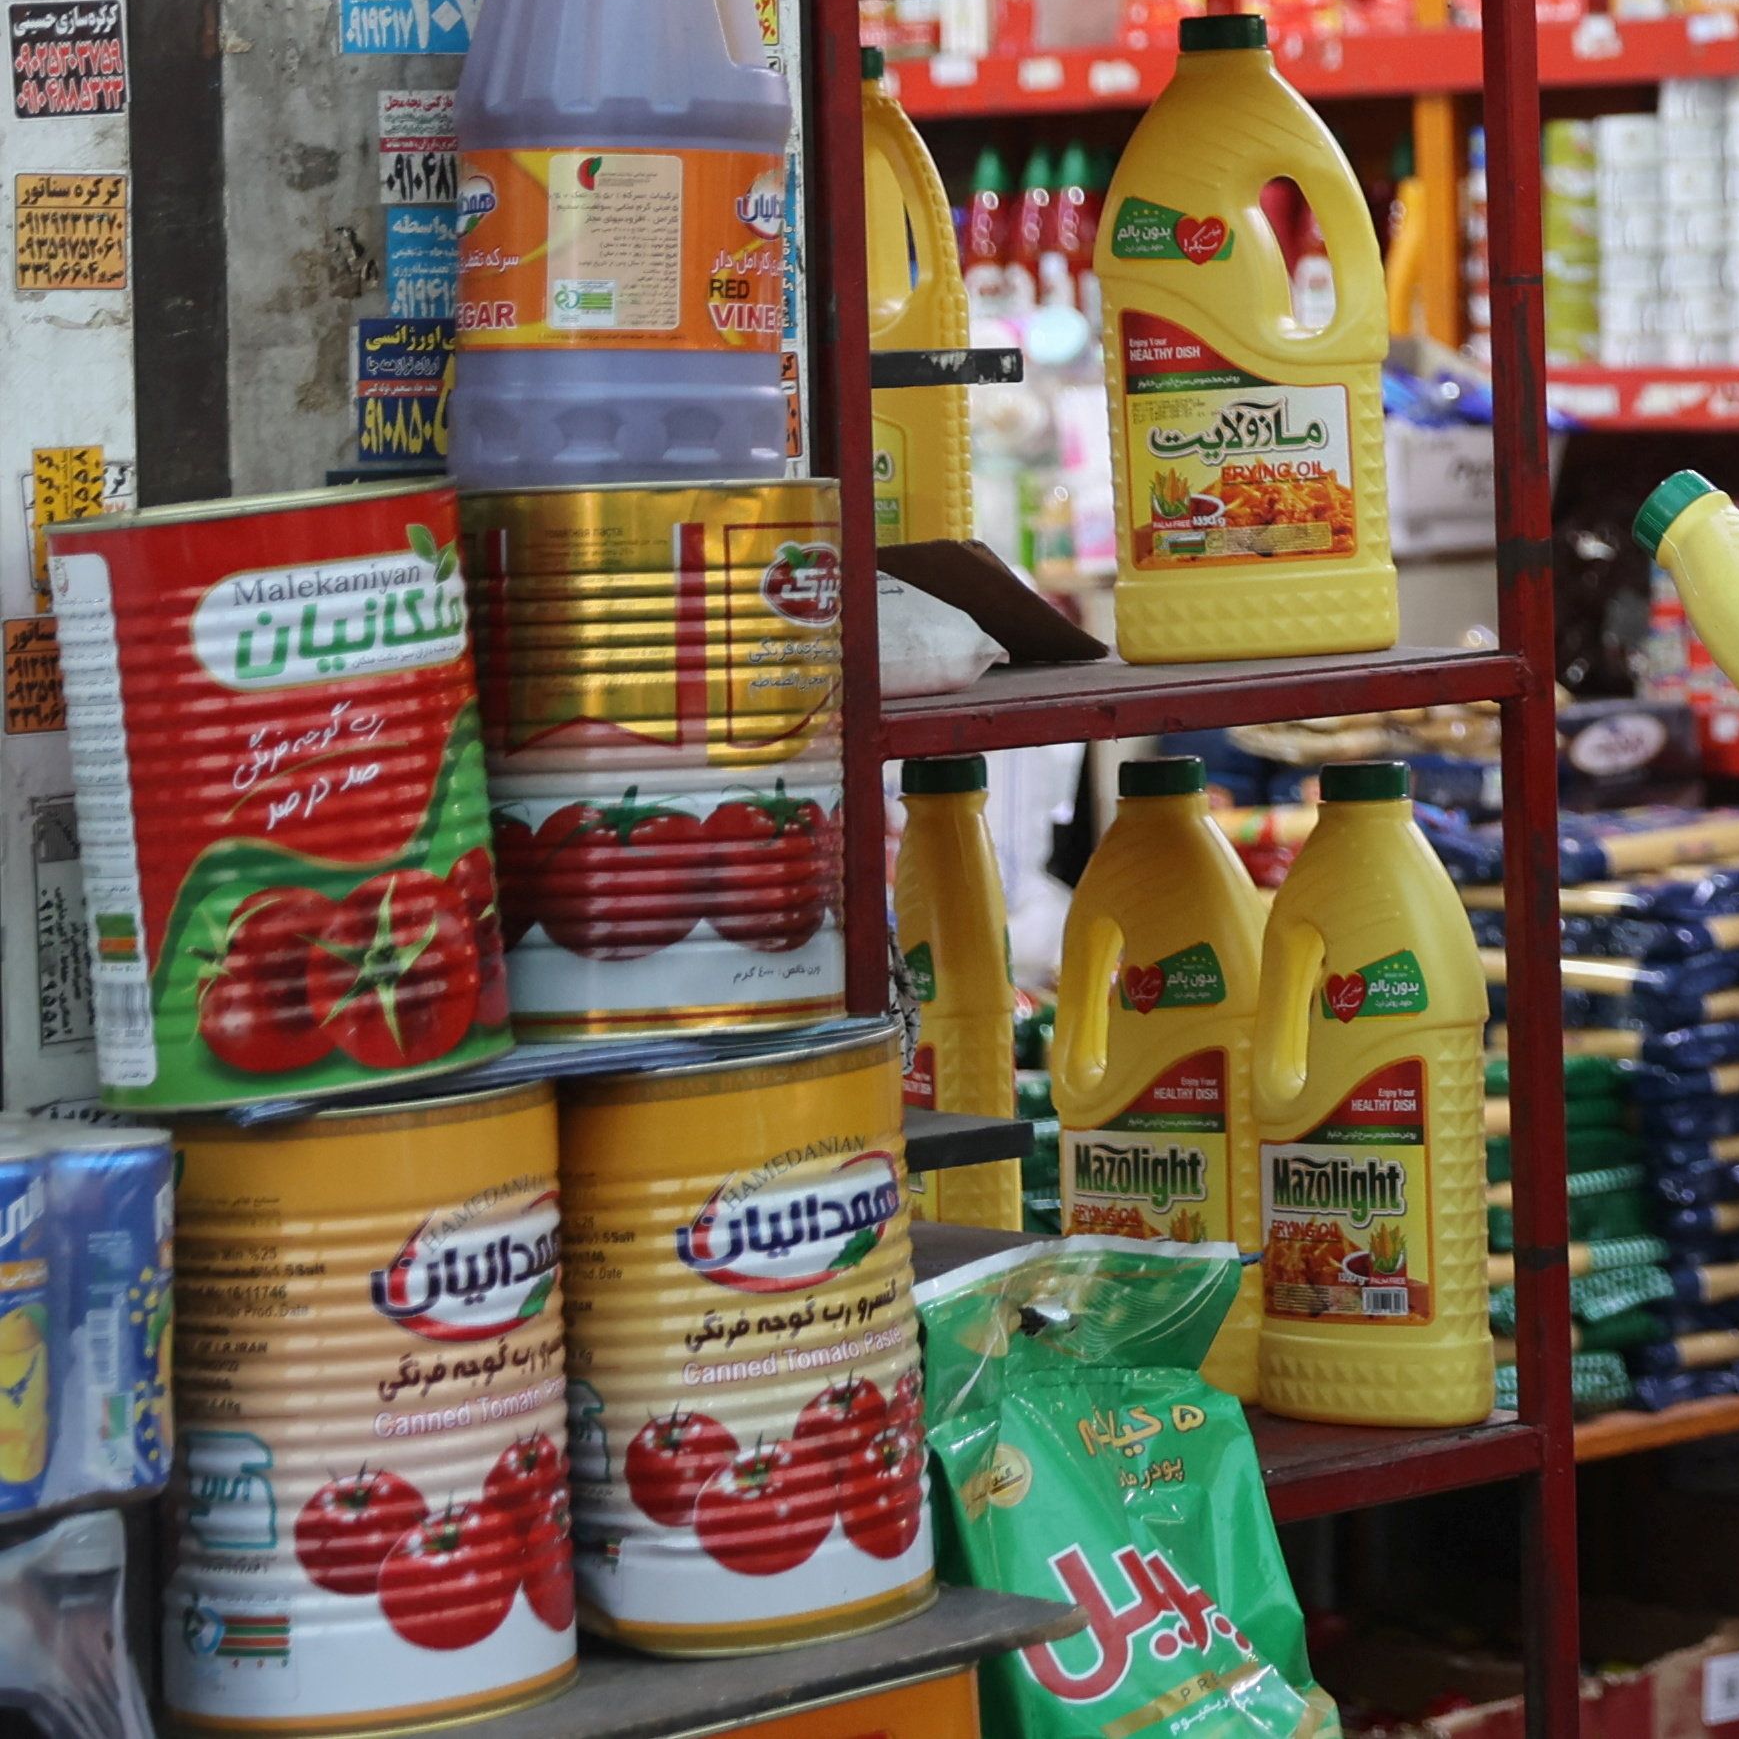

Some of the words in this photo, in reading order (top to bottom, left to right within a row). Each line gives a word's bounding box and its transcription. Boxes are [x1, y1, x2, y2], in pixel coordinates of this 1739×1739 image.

[14, 11, 57, 37] حسینی
[20, 176, 71, 205] سناتور
[73, 177, 123, 205] کرکره
[1117, 225, 1141, 243] پالم
[1142, 227, 1172, 240] بدون
[709, 279, 750, 298] RED
[456, 303, 516, 331] EGAR
[365, 324, 442, 351] اورژانسی
[1128, 338, 1150, 348] Enjoy
[1129, 347, 1173, 362] HEALTHY
[1175, 345, 1201, 360] DISH
[1151, 398, 1323, 459] مازولایت
[1221, 462, 1295, 484] FRYING
[1299, 460, 1327, 481] OIL
[232, 563, 421, 606] Malekaniyan
[234, 586, 462, 679] ملکانیان
[1166, 970, 1189, 991] پالم
[1191, 971, 1218, 987] بدون
[1368, 978, 1391, 998] پالم
[1392, 980, 1420, 995] بدون
[1154, 1086, 1195, 1101] HEALTHY
[1196, 1086, 1219, 1101] DISH
[1352, 1098, 1391, 1112] HEALTHY
[1393, 1098, 1417, 1112] DISH
[1377, 1088, 1397, 1099] Enjoy
[721, 1135, 866, 1210] HAMEDANIAN
[1075, 1142, 1204, 1206] Mazolight
[1272, 1156, 1402, 1221] Mazolight
[676, 1179, 899, 1269] همدانیان
[757, 1294, 816, 1337] گوجه
[822, 1299, 855, 1329] رب
[684, 1309, 750, 1352] فرنگی
[452, 1339, 506, 1387] گوجه
[680, 1350, 780, 1387] Canned
[783, 1338, 861, 1373] Tomato
[862, 1324, 903, 1356] Paste
[377, 1355, 448, 1401] فرنگی
[373, 1407, 473, 1439] Canned
[1171, 1405, 1206, 1433] ۵
[1139, 1456, 1184, 1490] پودر
